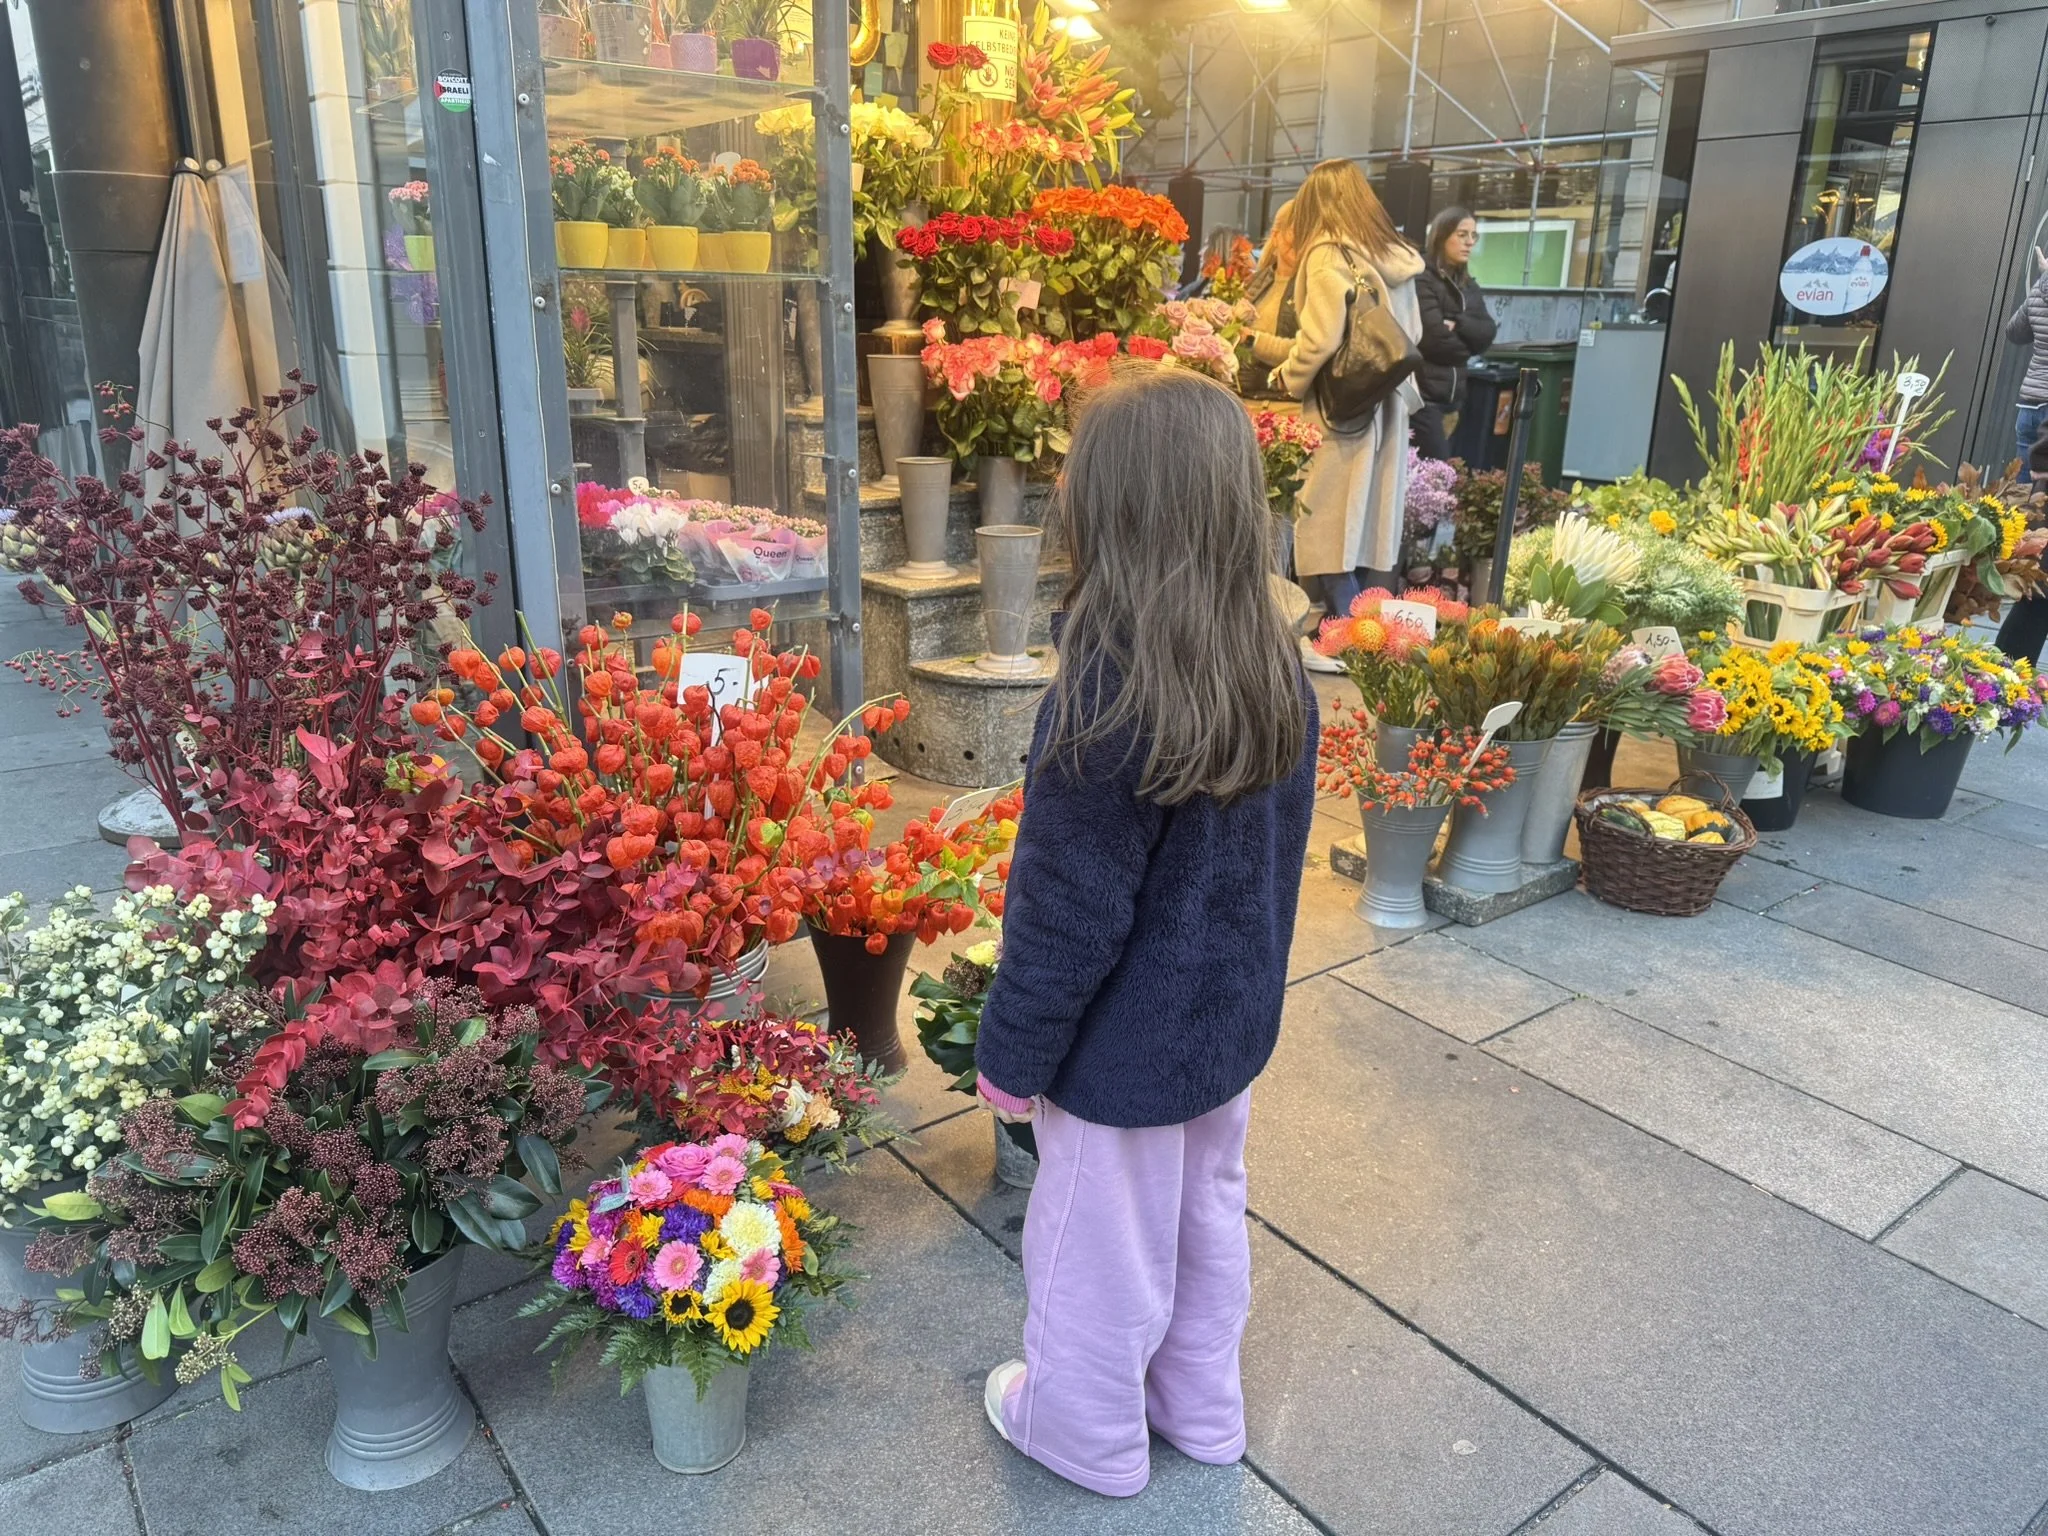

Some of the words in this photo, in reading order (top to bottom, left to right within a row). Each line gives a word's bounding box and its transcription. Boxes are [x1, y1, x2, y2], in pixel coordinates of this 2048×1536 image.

[437, 75, 468, 83] BOYCOTT
[439, 86, 469, 94] ISRAELI
[1796, 288, 1834, 301] evian
[753, 546, 788, 559] Queen
